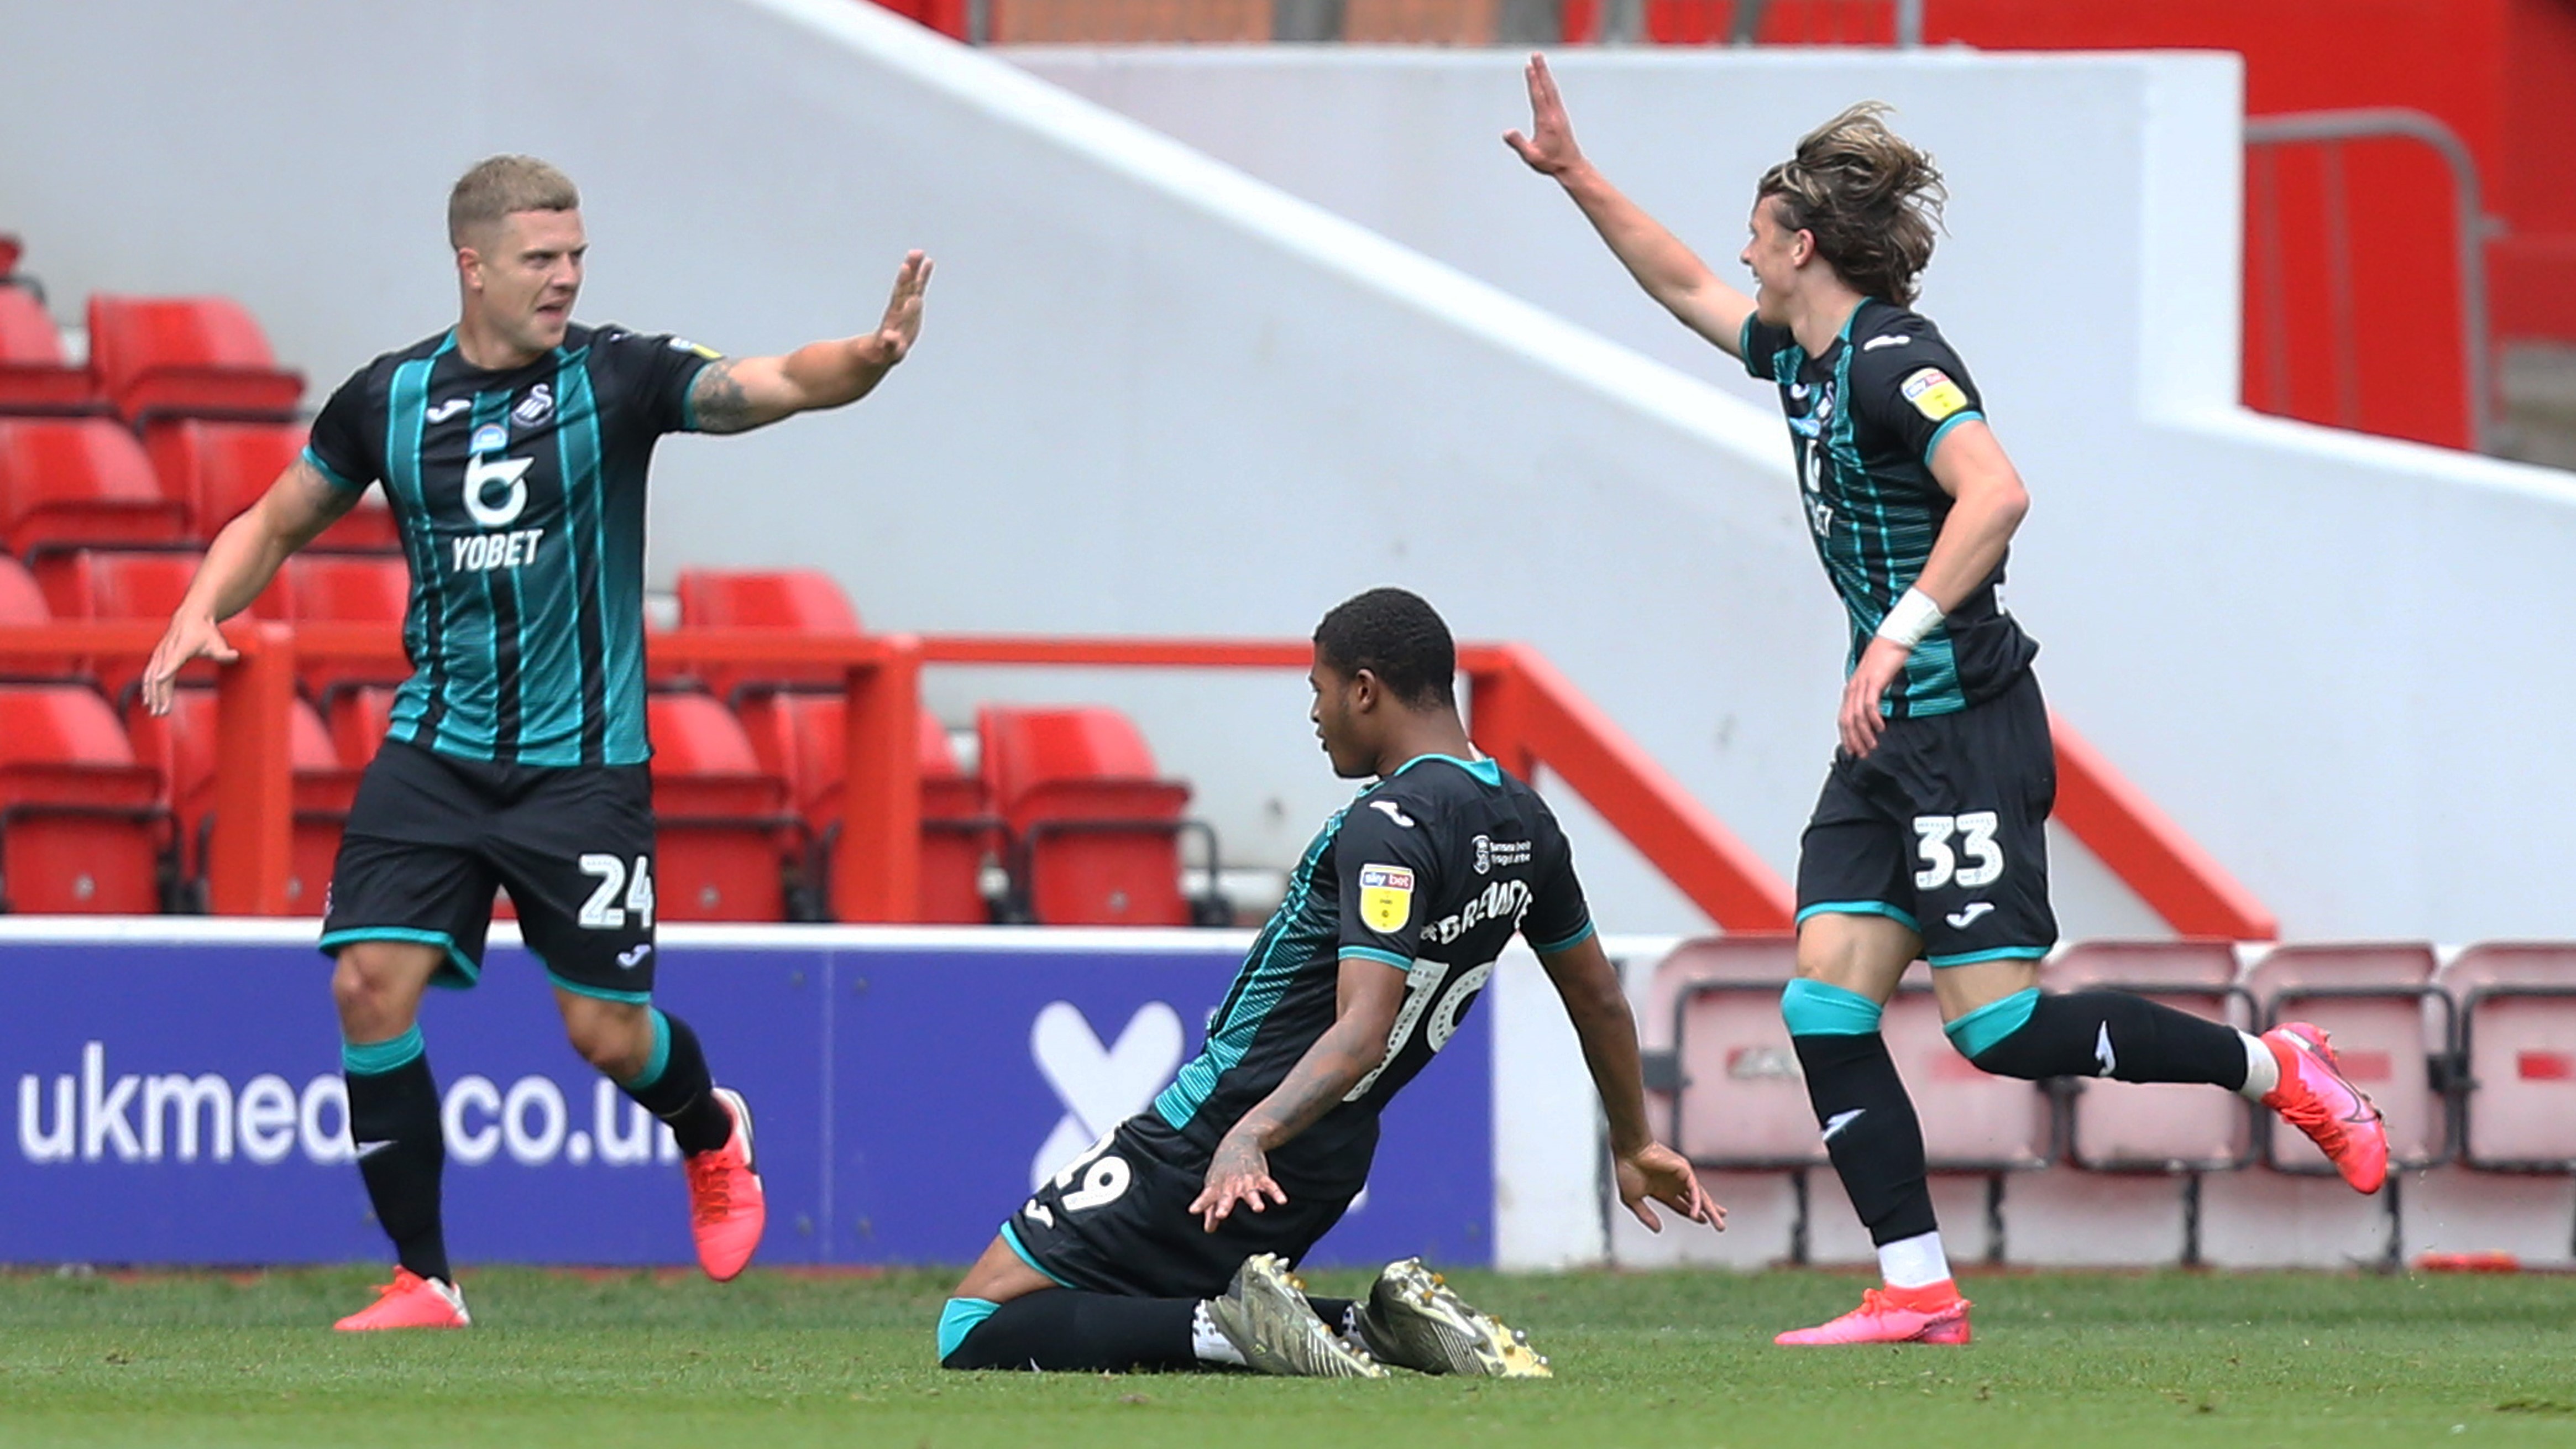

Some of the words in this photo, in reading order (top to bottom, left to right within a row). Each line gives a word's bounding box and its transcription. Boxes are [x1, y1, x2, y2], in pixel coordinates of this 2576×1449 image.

[453, 529, 544, 572] YOBET
[1365, 871, 1386, 887] sky
[1389, 873, 1410, 887] bet
[1913, 811, 2003, 891] 33
[578, 853, 655, 930] 24
